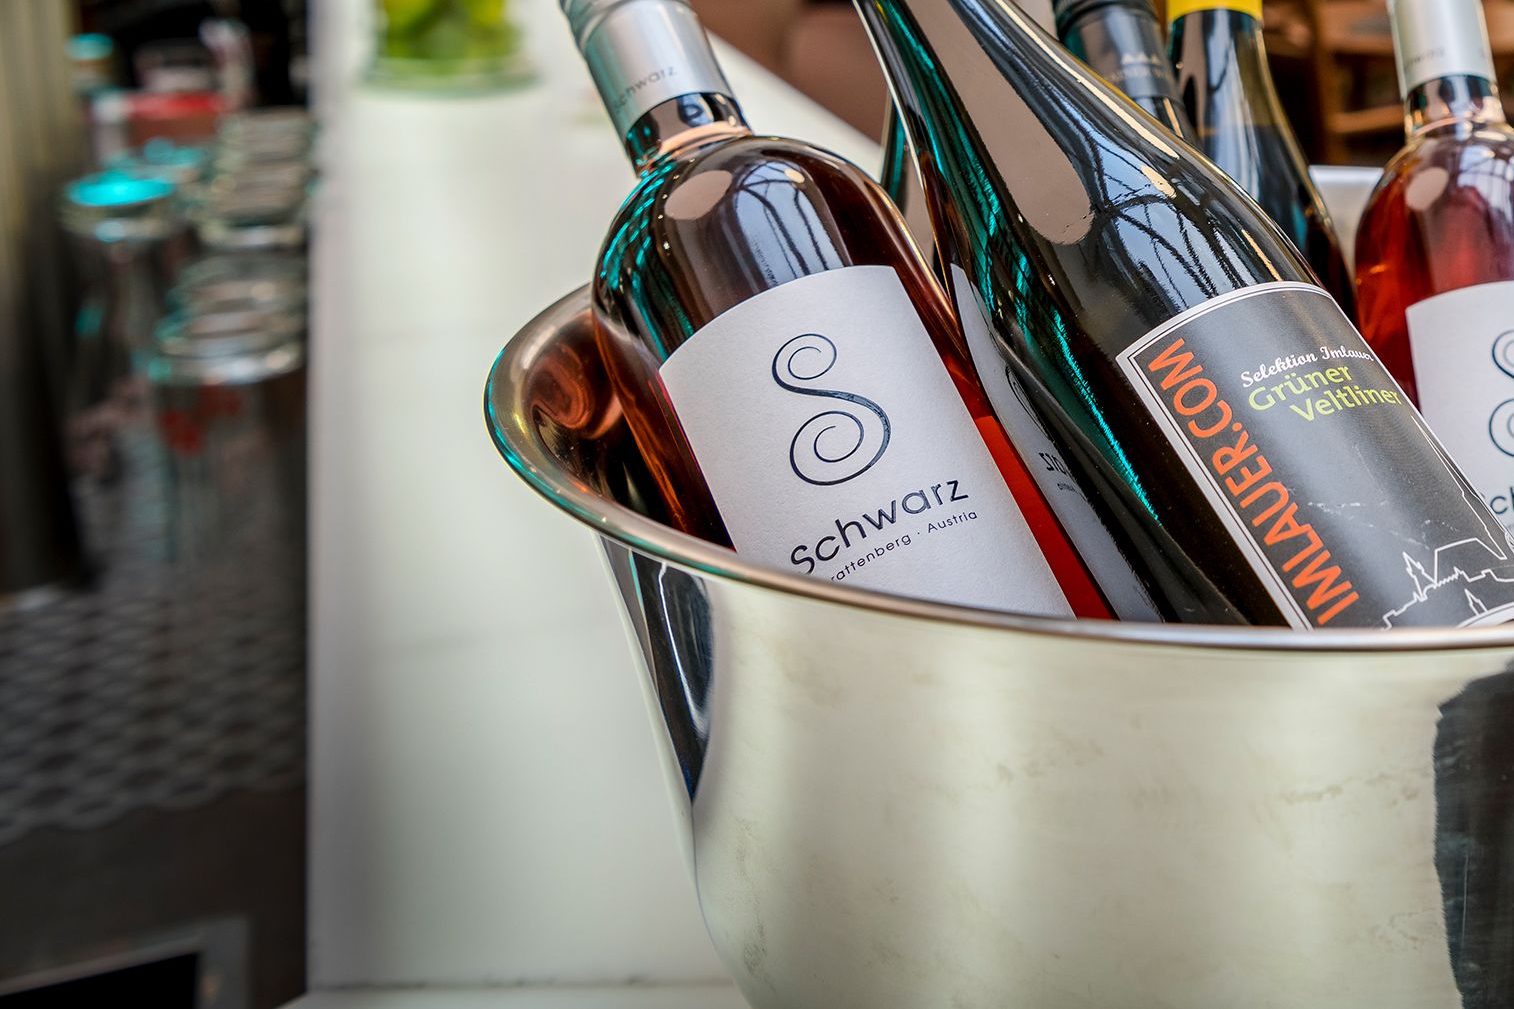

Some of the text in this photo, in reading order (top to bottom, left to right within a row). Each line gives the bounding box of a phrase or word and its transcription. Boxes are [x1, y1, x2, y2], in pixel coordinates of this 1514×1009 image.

[1241, 352, 1318, 388] Selektion
[1248, 365, 1352, 411] Grüner
[1289, 385, 1402, 422] Veltliner
[1148, 337, 1360, 625] IMLAUER.COM
[790, 480, 968, 575] Schwarz
[830, 510, 978, 581] rattenberg Austria
